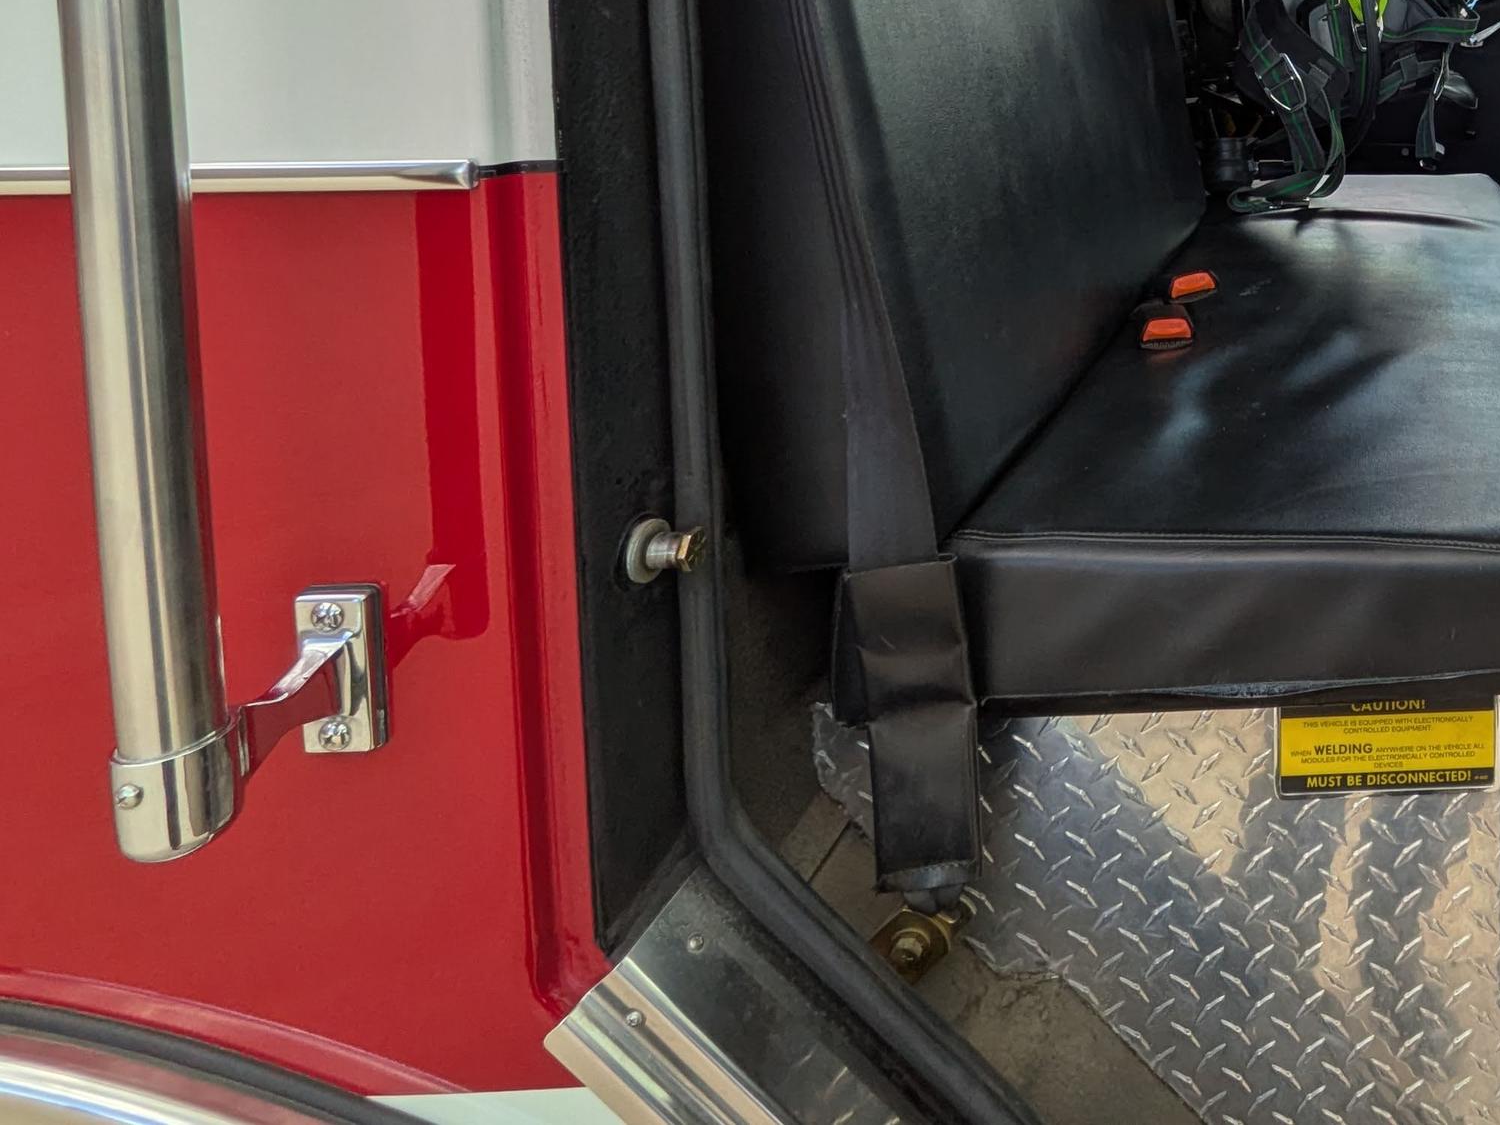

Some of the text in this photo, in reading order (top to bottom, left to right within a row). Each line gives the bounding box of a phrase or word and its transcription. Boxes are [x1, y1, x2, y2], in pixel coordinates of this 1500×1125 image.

[1351, 699, 1425, 712] CAUTION!
[1358, 718, 1393, 726] EQUIPPED
[1414, 715, 1473, 723] ELECTRONICALLY
[1343, 726, 1390, 734] CONTROLLED
[1314, 743, 1373, 755] WELDING
[1375, 745, 1414, 753] ANYWHERE
[1443, 743, 1472, 751] VEHICLE
[1300, 756, 1336, 764] MODULES
[1368, 751, 1428, 761] ELECTRONICALLY
[1429, 750, 1476, 759] CONTROLLED
[1306, 775, 1343, 788] MUST
[1346, 775, 1362, 786] BE
[1366, 770, 1472, 786] DISCONNECTED!
